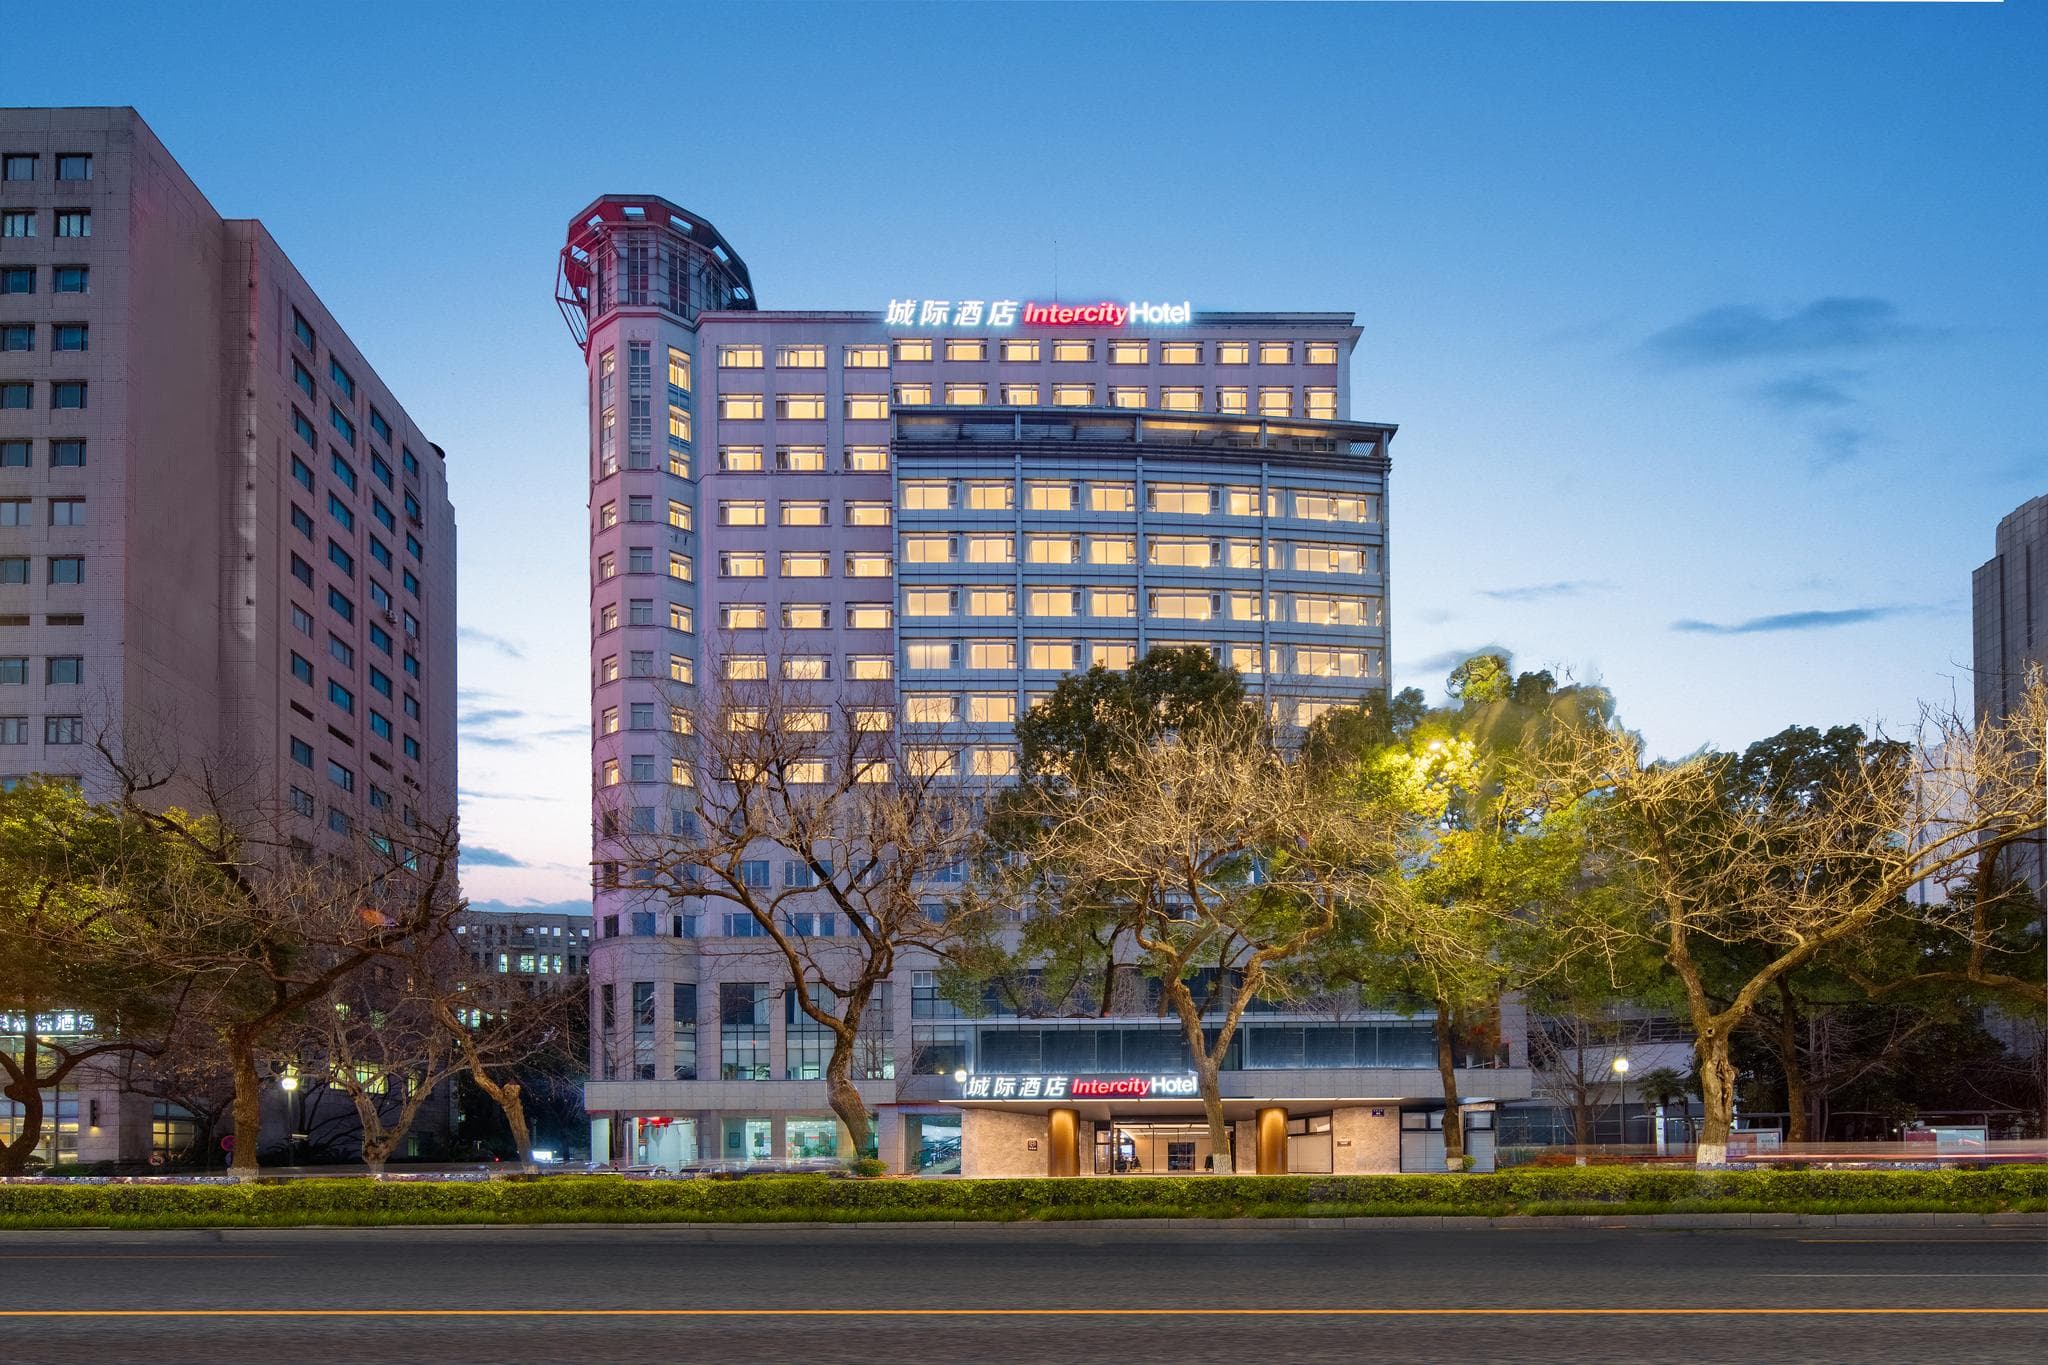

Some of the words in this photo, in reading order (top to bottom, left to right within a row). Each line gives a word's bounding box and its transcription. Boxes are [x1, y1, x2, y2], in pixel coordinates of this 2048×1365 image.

[885, 299, 1018, 326] 城际酒店
[967, 1076, 1068, 1097] 城际酒店
